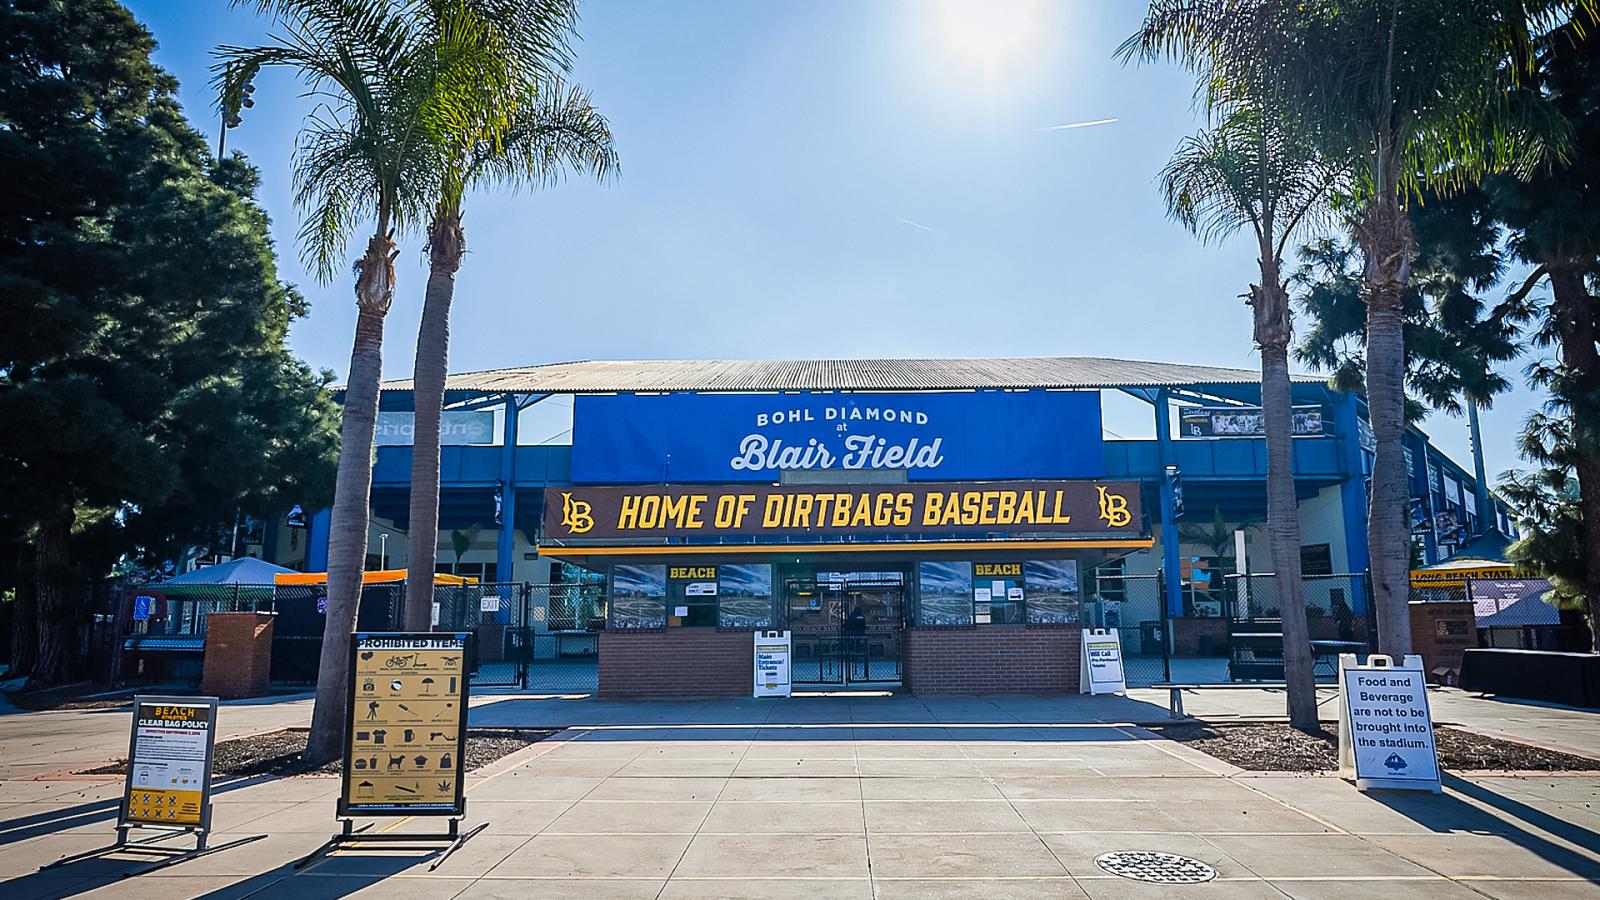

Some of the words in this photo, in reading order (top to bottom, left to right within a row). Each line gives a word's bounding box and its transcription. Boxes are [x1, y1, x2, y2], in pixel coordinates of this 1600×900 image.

[756, 408, 815, 426] BOHL
[825, 407, 928, 425] DIAMOND
[836, 422, 848, 432] at
[730, 434, 836, 471] Blair
[842, 434, 944, 470] Field
[617, 494, 708, 529] HOME
[714, 494, 756, 528] OF
[762, 492, 914, 528] DIRTBAGS
[922, 490, 1071, 526] BASEBALL
[1095, 485, 1132, 528] LB
[560, 492, 594, 534] LB
[670, 567, 716, 578] BEACH
[975, 564, 1021, 575] BEACH
[1415, 573, 1442, 581] LONG
[1446, 571, 1478, 580] BEACH
[1482, 570, 1513, 579] STATE
[481, 600, 499, 610] EXIT
[360, 639, 429, 648] PROHIBITED
[431, 639, 464, 648] ITEMS
[1358, 677, 1387, 687] Food
[1390, 678, 1411, 687] and
[1360, 692, 1413, 704] Beverage
[155, 706, 194, 716] BEACH
[1354, 708, 1371, 716] are
[1374, 708, 1393, 717] not
[1396, 709, 1407, 717] to
[1410, 708, 1425, 717] be
[138, 719, 164, 727] CLEAR
[164, 720, 181, 728] BAG
[181, 720, 209, 729] POLICY
[1356, 722, 1401, 734] brought
[1404, 723, 1426, 733] into
[1358, 737, 1376, 747] the
[1379, 738, 1429, 749] stadium.
